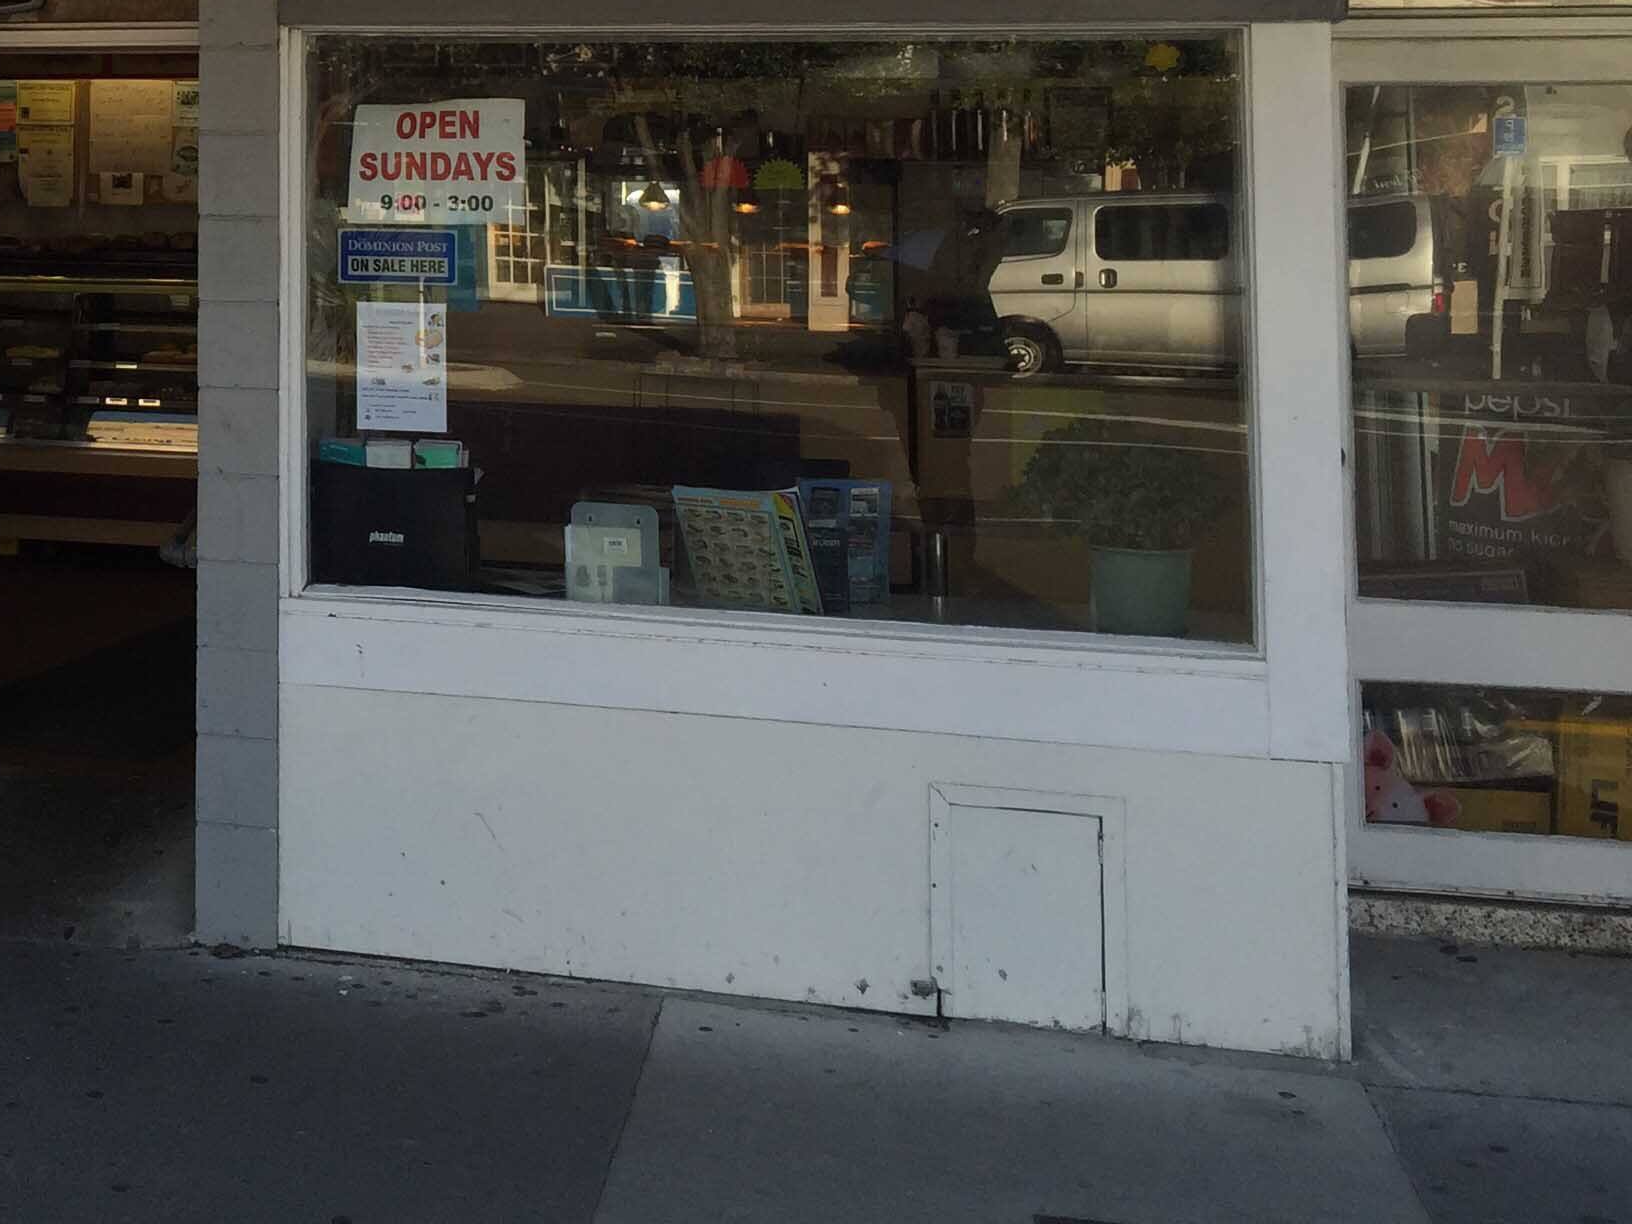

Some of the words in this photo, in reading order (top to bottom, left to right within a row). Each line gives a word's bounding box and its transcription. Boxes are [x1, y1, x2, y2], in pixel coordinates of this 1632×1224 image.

[396, 110, 480, 139] OPEN
[359, 152, 516, 181] SUNDAYS
[380, 194, 427, 211] 9:00
[447, 195, 494, 212] 3:00
[348, 239, 414, 253] DOMINION
[416, 240, 449, 253] POST
[351, 258, 370, 272] ON
[373, 258, 406, 273] SALE
[411, 259, 446, 274] HERE
[1448, 519, 1523, 543] maximum
[1467, 541, 1513, 560] sugar
